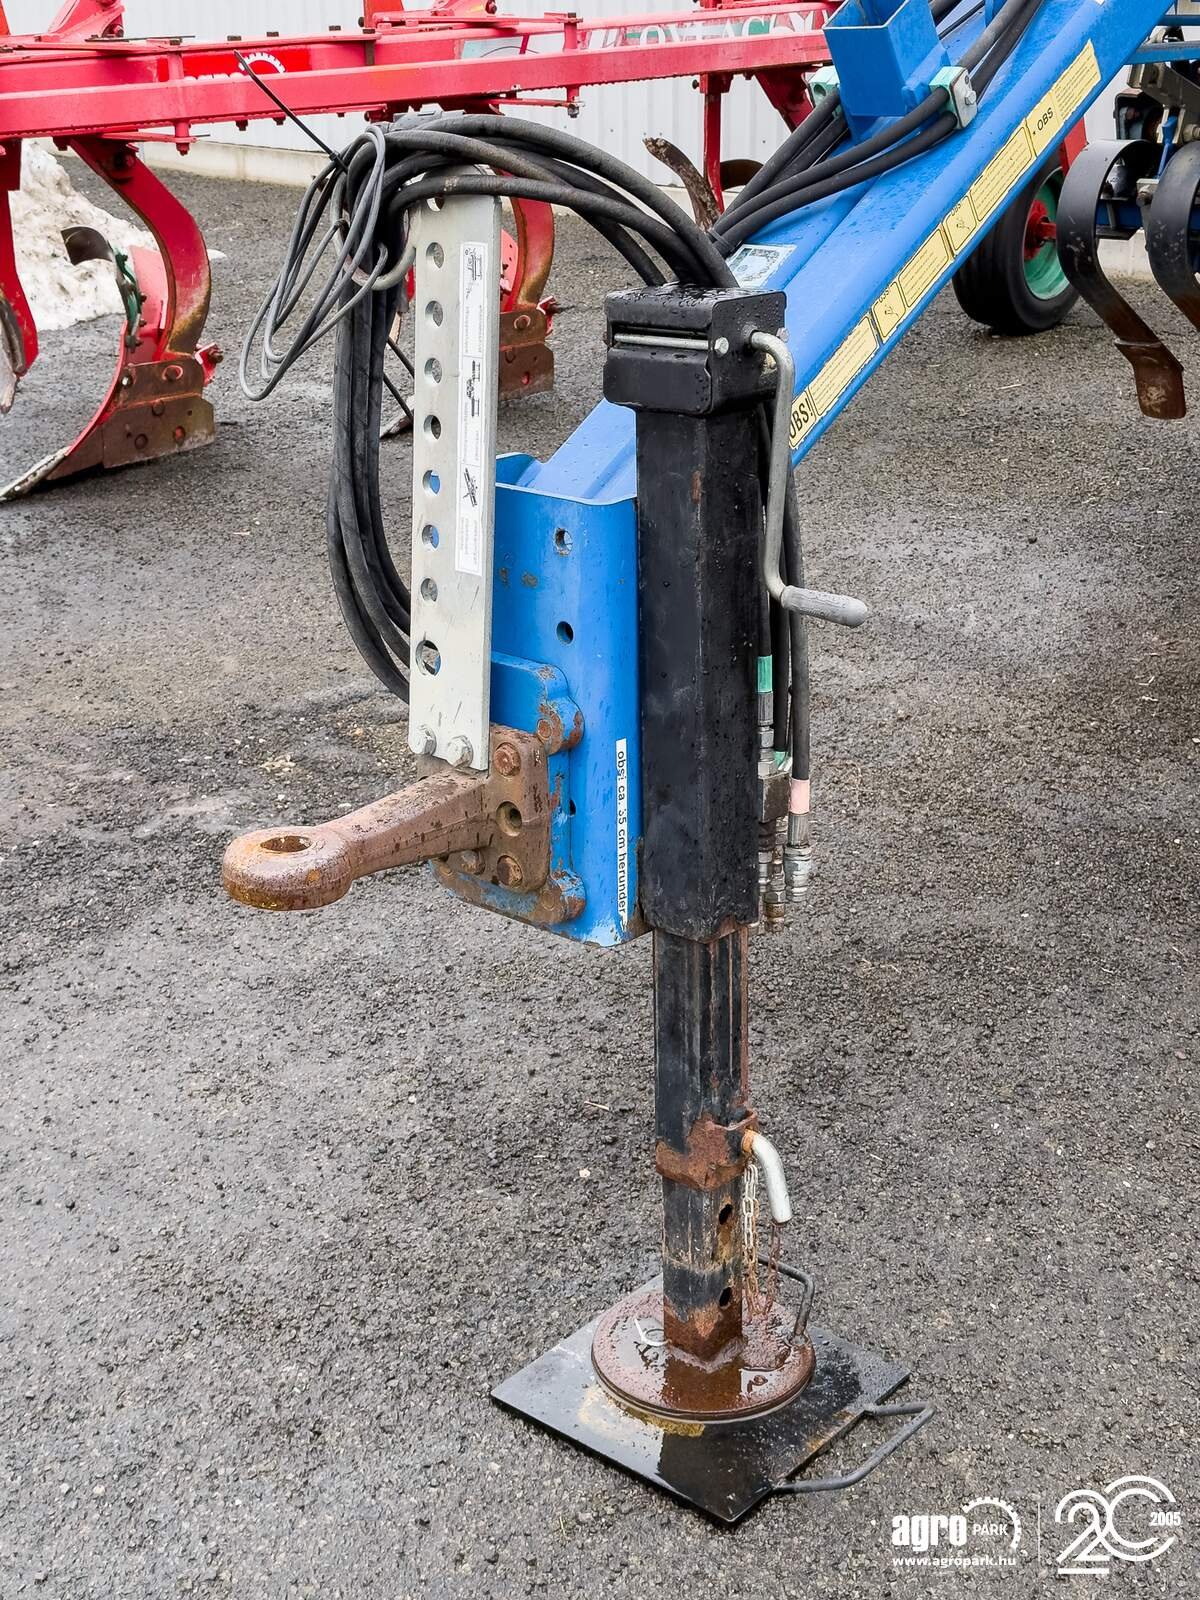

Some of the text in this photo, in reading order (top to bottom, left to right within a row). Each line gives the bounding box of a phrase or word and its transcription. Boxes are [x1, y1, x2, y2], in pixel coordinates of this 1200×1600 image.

[1036, 106, 1054, 132] OBS
[618, 785, 626, 805] ca.
[618, 829, 626, 849] cm
[618, 852, 628, 914] herunder
